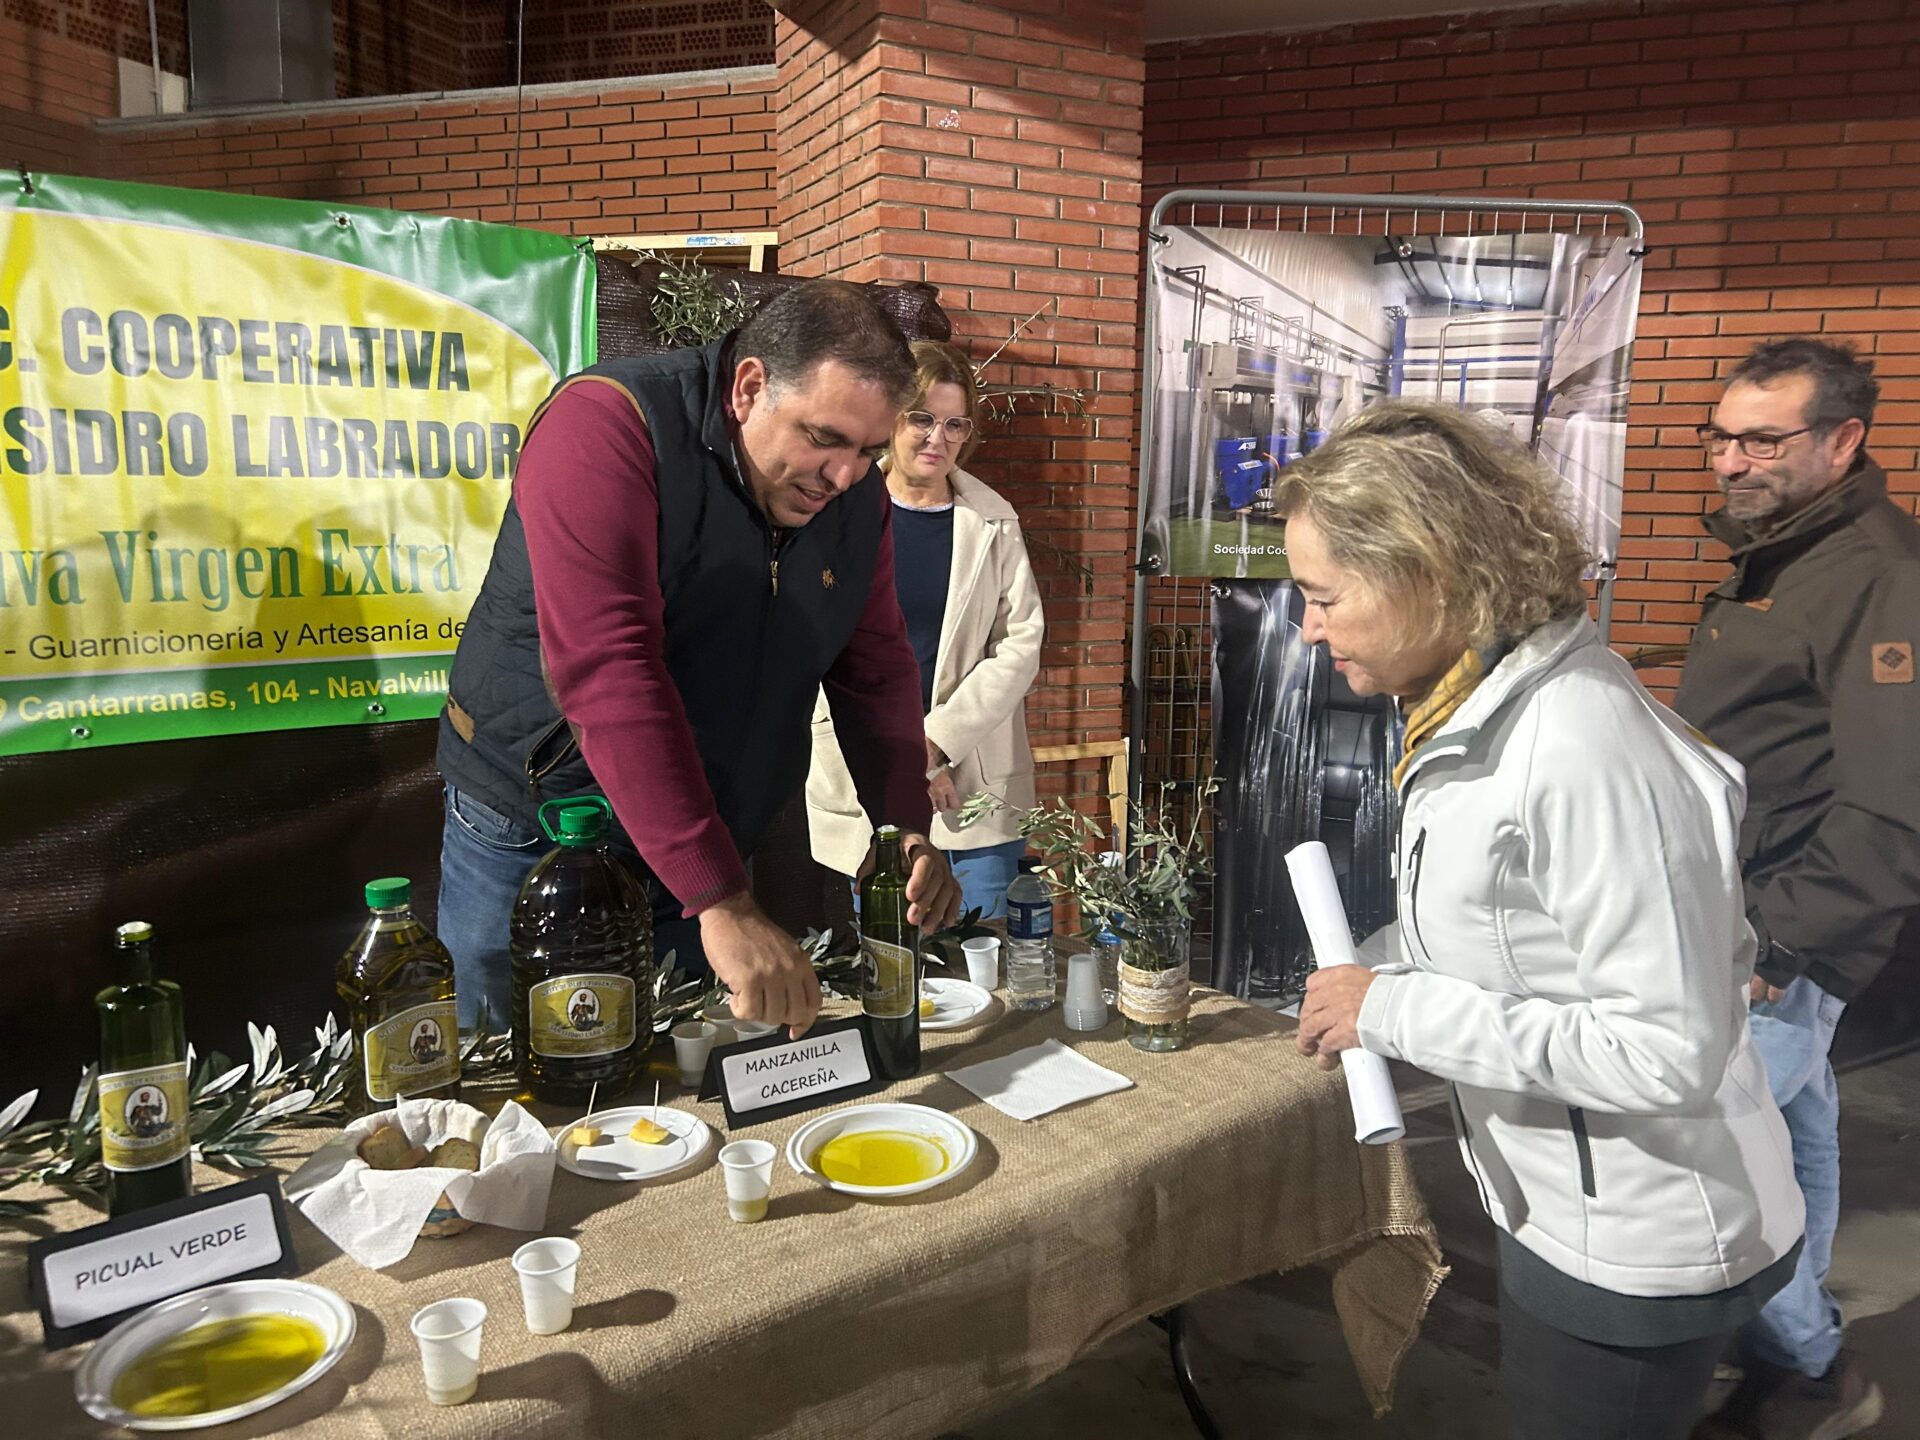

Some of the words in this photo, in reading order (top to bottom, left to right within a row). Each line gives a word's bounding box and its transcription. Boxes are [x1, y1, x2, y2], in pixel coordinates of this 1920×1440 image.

[61, 306, 470, 392] COOPERATIVA
[0, 406, 208, 477] SIDRO
[232, 414, 520, 480] LABRADOR
[99, 529, 304, 612] Virgen
[317, 528, 462, 597] Extra
[1214, 544, 1264, 555] Sociedad
[29, 624, 263, 660] Guarnicionería
[273, 629, 289, 654] y
[297, 618, 428, 647] Artesanía
[18, 688, 236, 722] Cantarranas,
[247, 679, 299, 705] 104
[328, 669, 449, 699] Navalvill
[746, 1041, 841, 1074] MANZANILLA
[761, 1068, 839, 1099] CACEREÑA
[75, 1252, 163, 1290] PICUAL
[170, 1223, 247, 1259] VERDE
